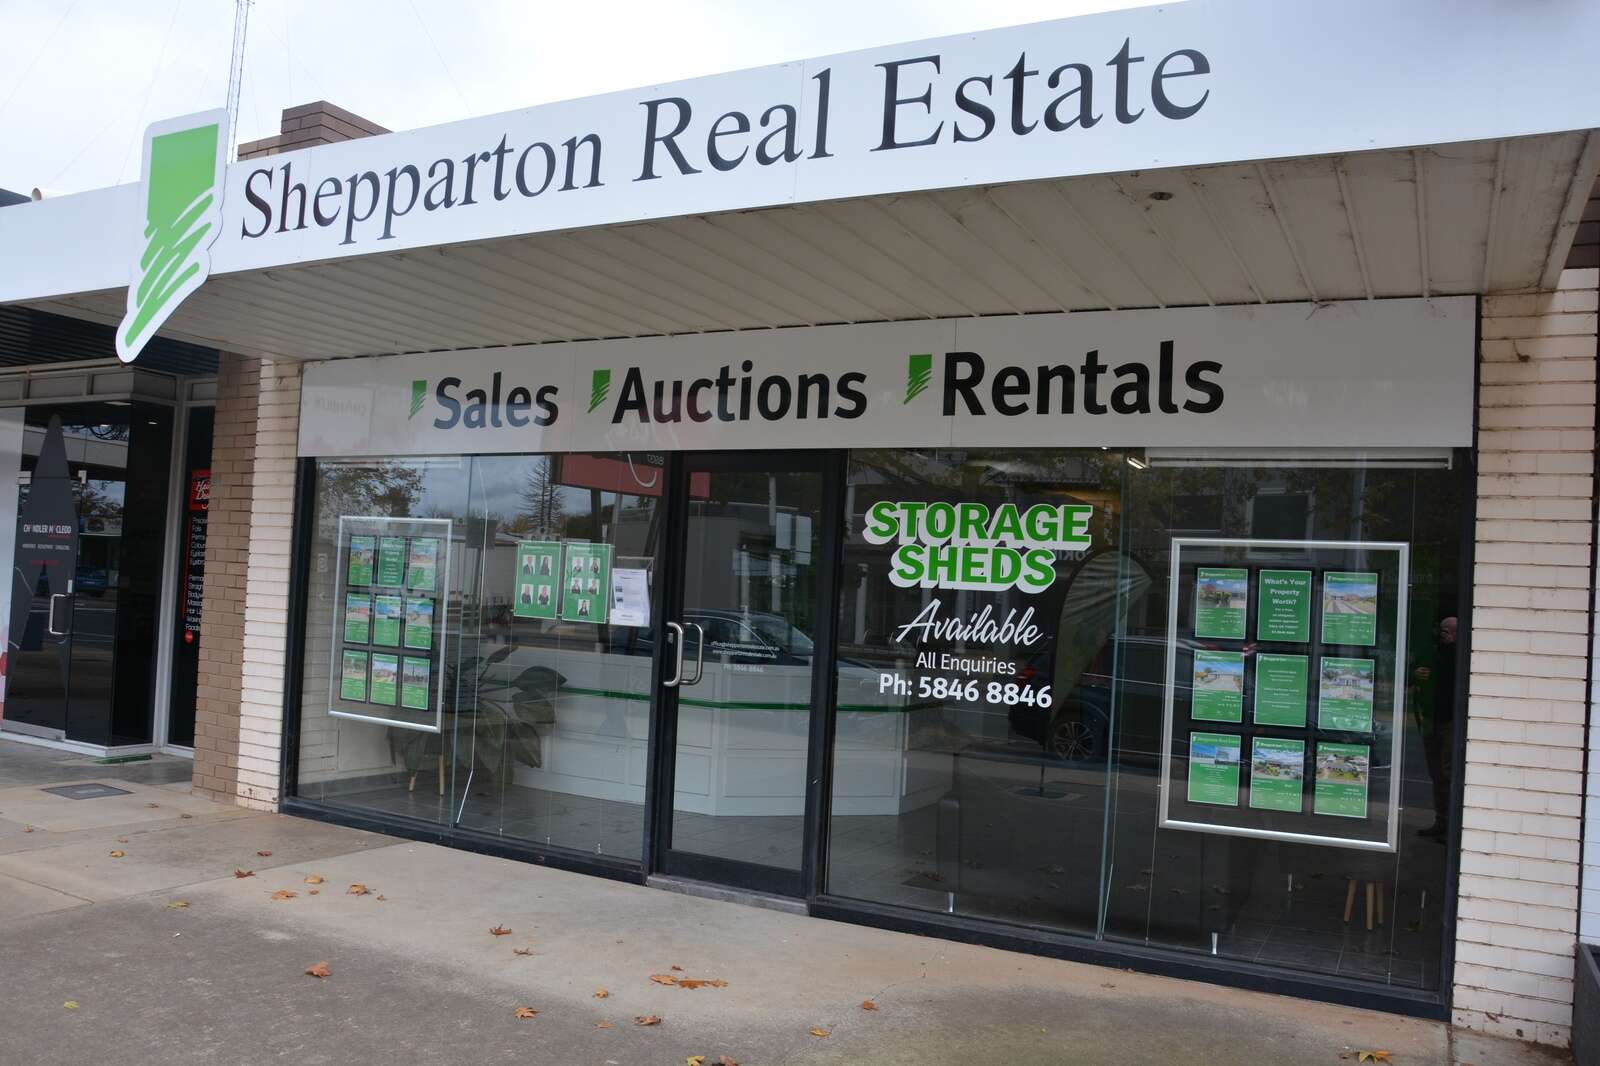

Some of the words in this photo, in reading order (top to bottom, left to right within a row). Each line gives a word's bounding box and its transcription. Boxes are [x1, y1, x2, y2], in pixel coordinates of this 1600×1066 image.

[240, 132, 604, 247] Shepparton
[632, 67, 833, 182] Real
[869, 36, 1212, 154] Estate
[432, 371, 560, 431] Sales
[611, 359, 868, 425] Auctions
[941, 340, 1226, 416] Rentals
[862, 501, 1094, 551] STORAGE
[888, 544, 1057, 594] SHEDS
[1270, 588, 1300, 597] Property
[895, 598, 1043, 646] Available
[915, 651, 937, 669] All
[940, 653, 1017, 676] Enquiries
[879, 673, 913, 696] Ph:
[918, 676, 980, 701] 5846
[985, 681, 1052, 708] 8846
